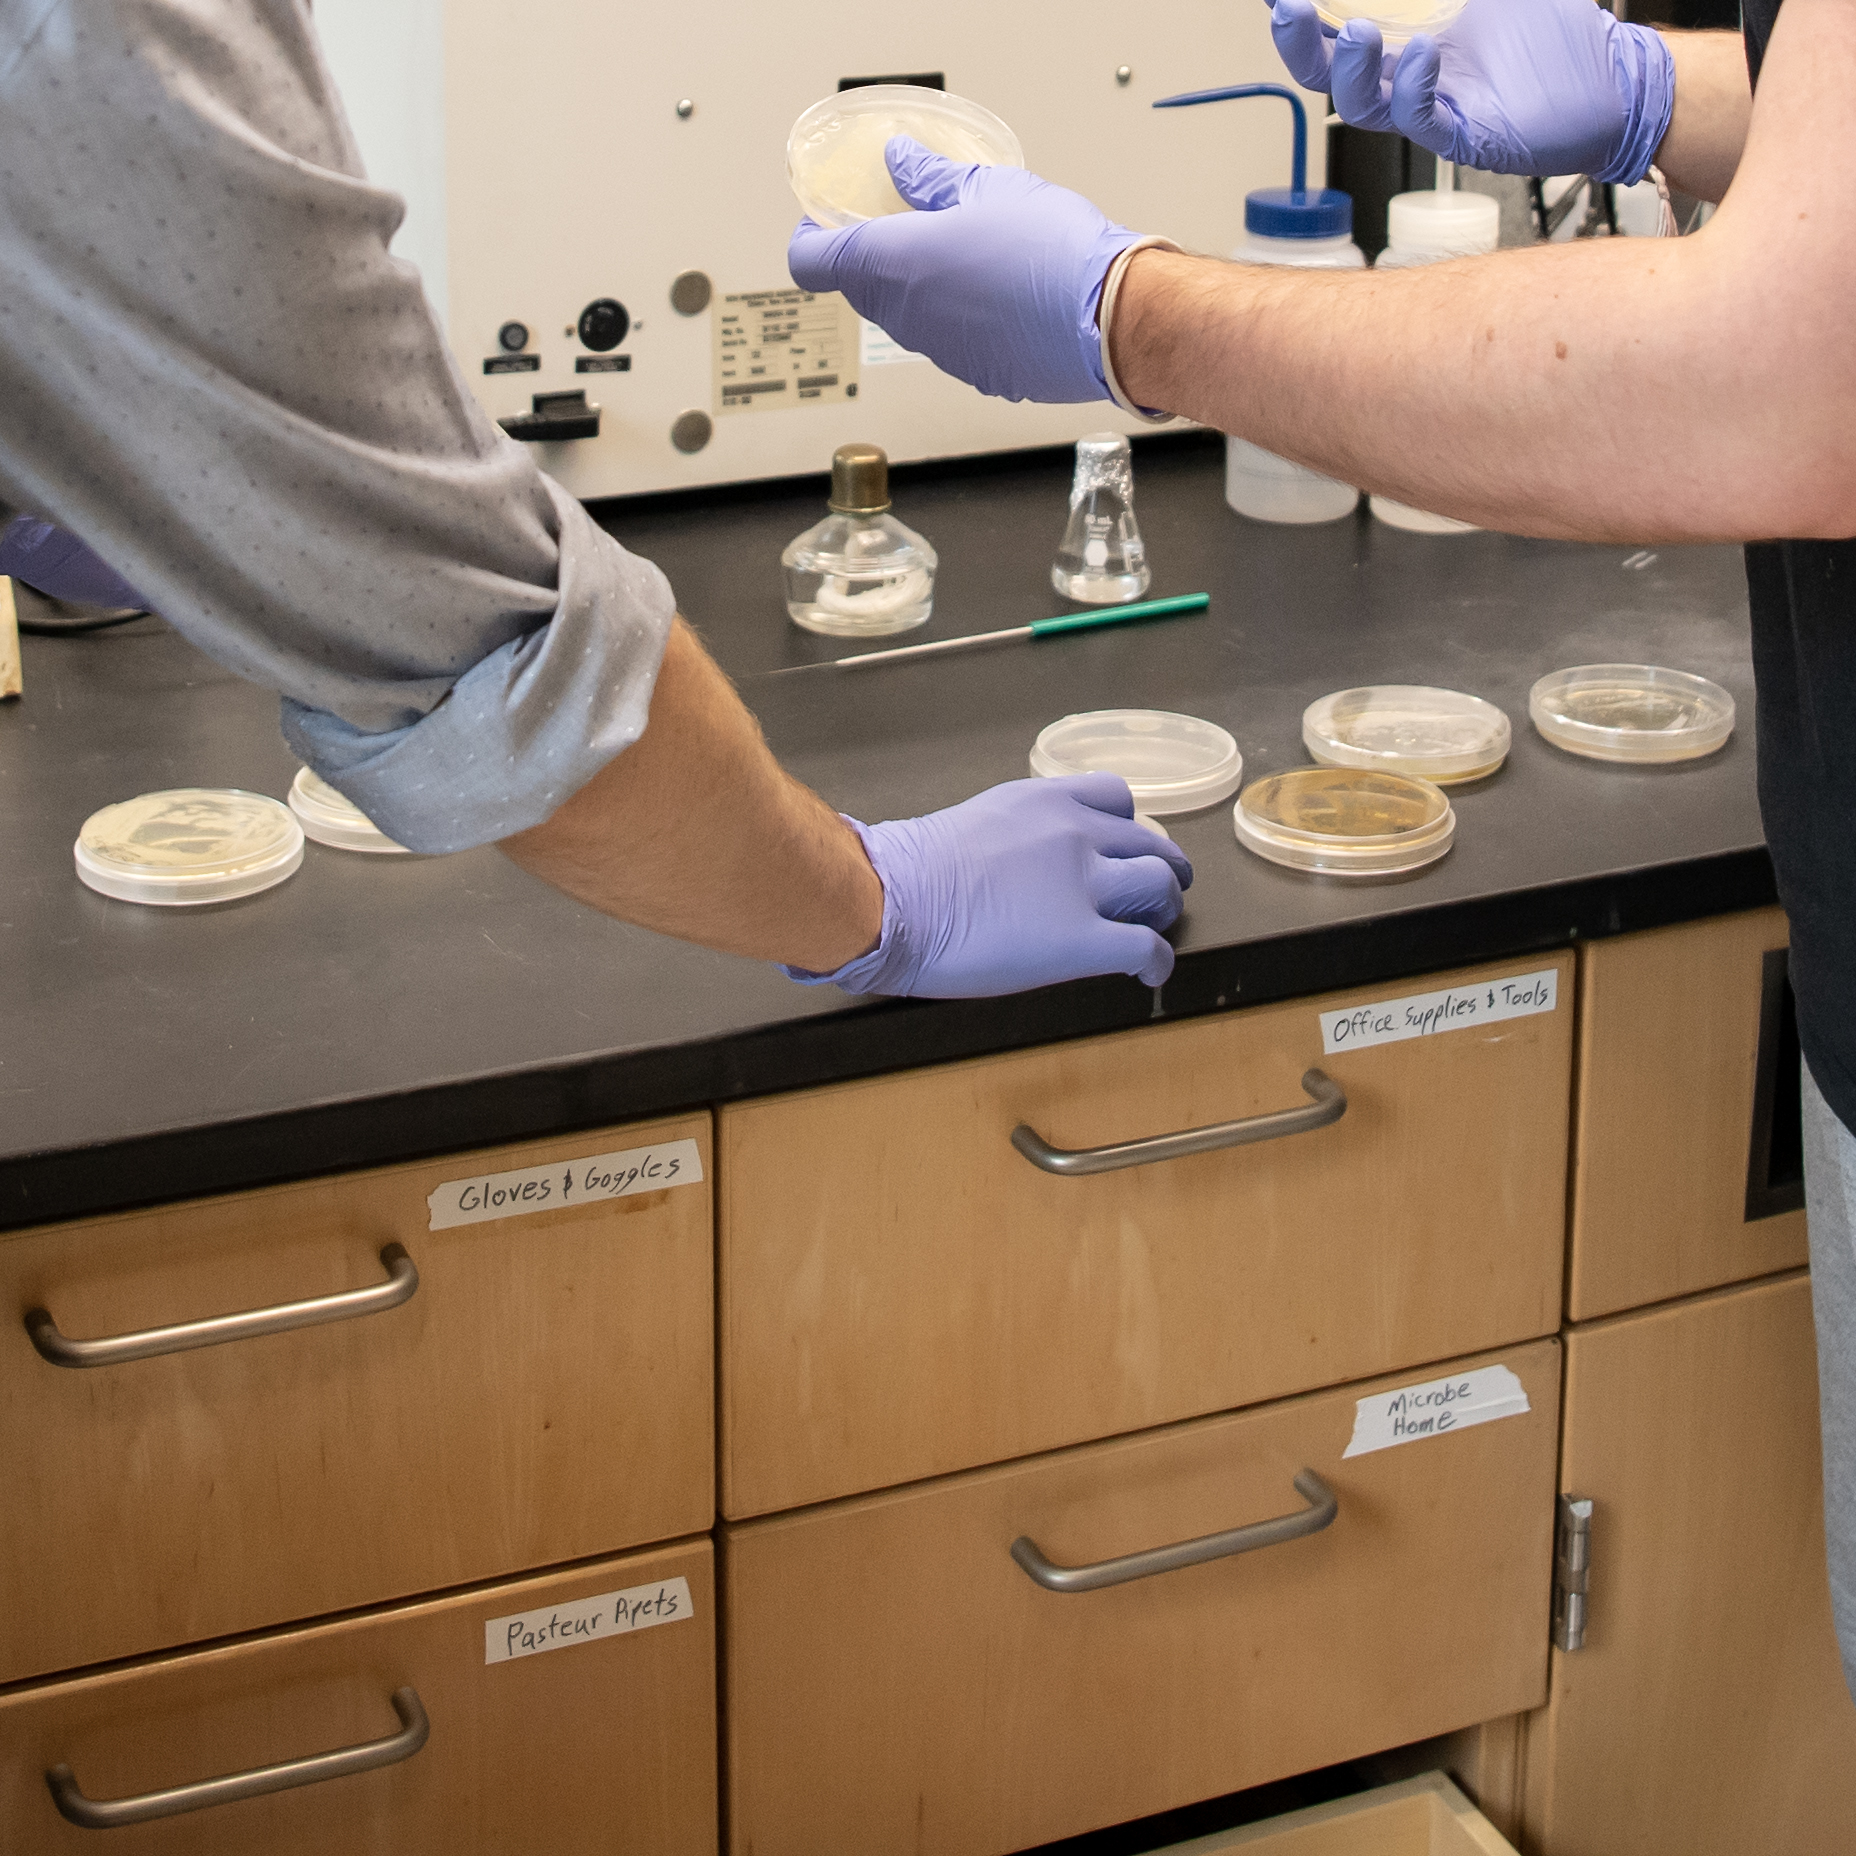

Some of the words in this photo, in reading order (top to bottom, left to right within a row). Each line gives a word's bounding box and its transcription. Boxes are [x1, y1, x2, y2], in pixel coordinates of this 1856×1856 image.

[1333, 1009, 1396, 1042] Office
[1405, 994, 1476, 1035] Supplies
[1501, 980, 1549, 1006] Tools
[458, 1178, 551, 1212] Gloves
[584, 1154, 681, 1195] Goggles
[1387, 1382, 1472, 1416] Microbe
[1393, 1410, 1457, 1436] Home
[507, 1613, 603, 1656] Pasteur
[615, 1588, 678, 1627] Pipets
